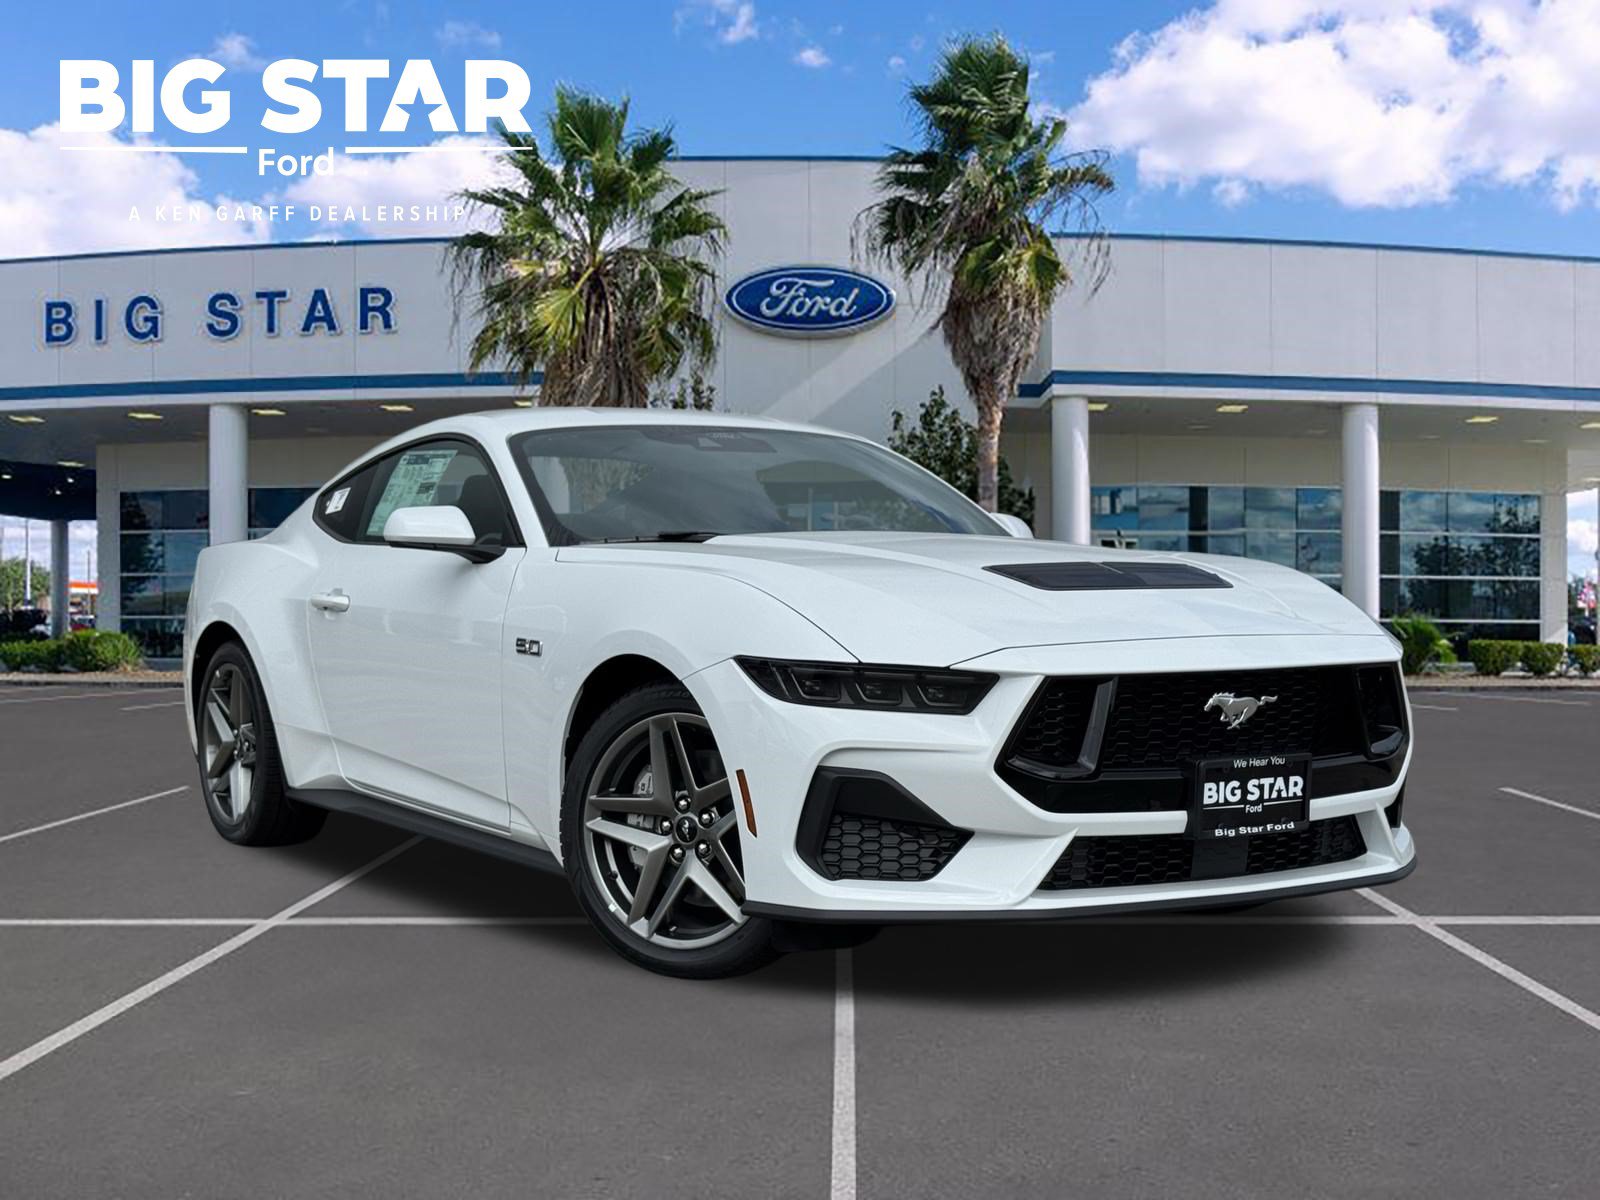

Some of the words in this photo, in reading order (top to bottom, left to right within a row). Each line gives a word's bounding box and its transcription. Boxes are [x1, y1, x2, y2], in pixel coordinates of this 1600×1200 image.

[760, 277, 859, 317] Ford
[45, 295, 162, 344] BIG
[206, 286, 397, 339] STAR
[1233, 759, 1247, 768] We
[1249, 758, 1269, 767] Hear
[1270, 756, 1286, 765] You
[1203, 781, 1241, 805] BIG
[1246, 776, 1303, 801] STAR
[1245, 804, 1262, 813] Ford
[1215, 828, 1236, 837] Big
[1239, 825, 1264, 834] Star
[1266, 821, 1295, 831] Ford
